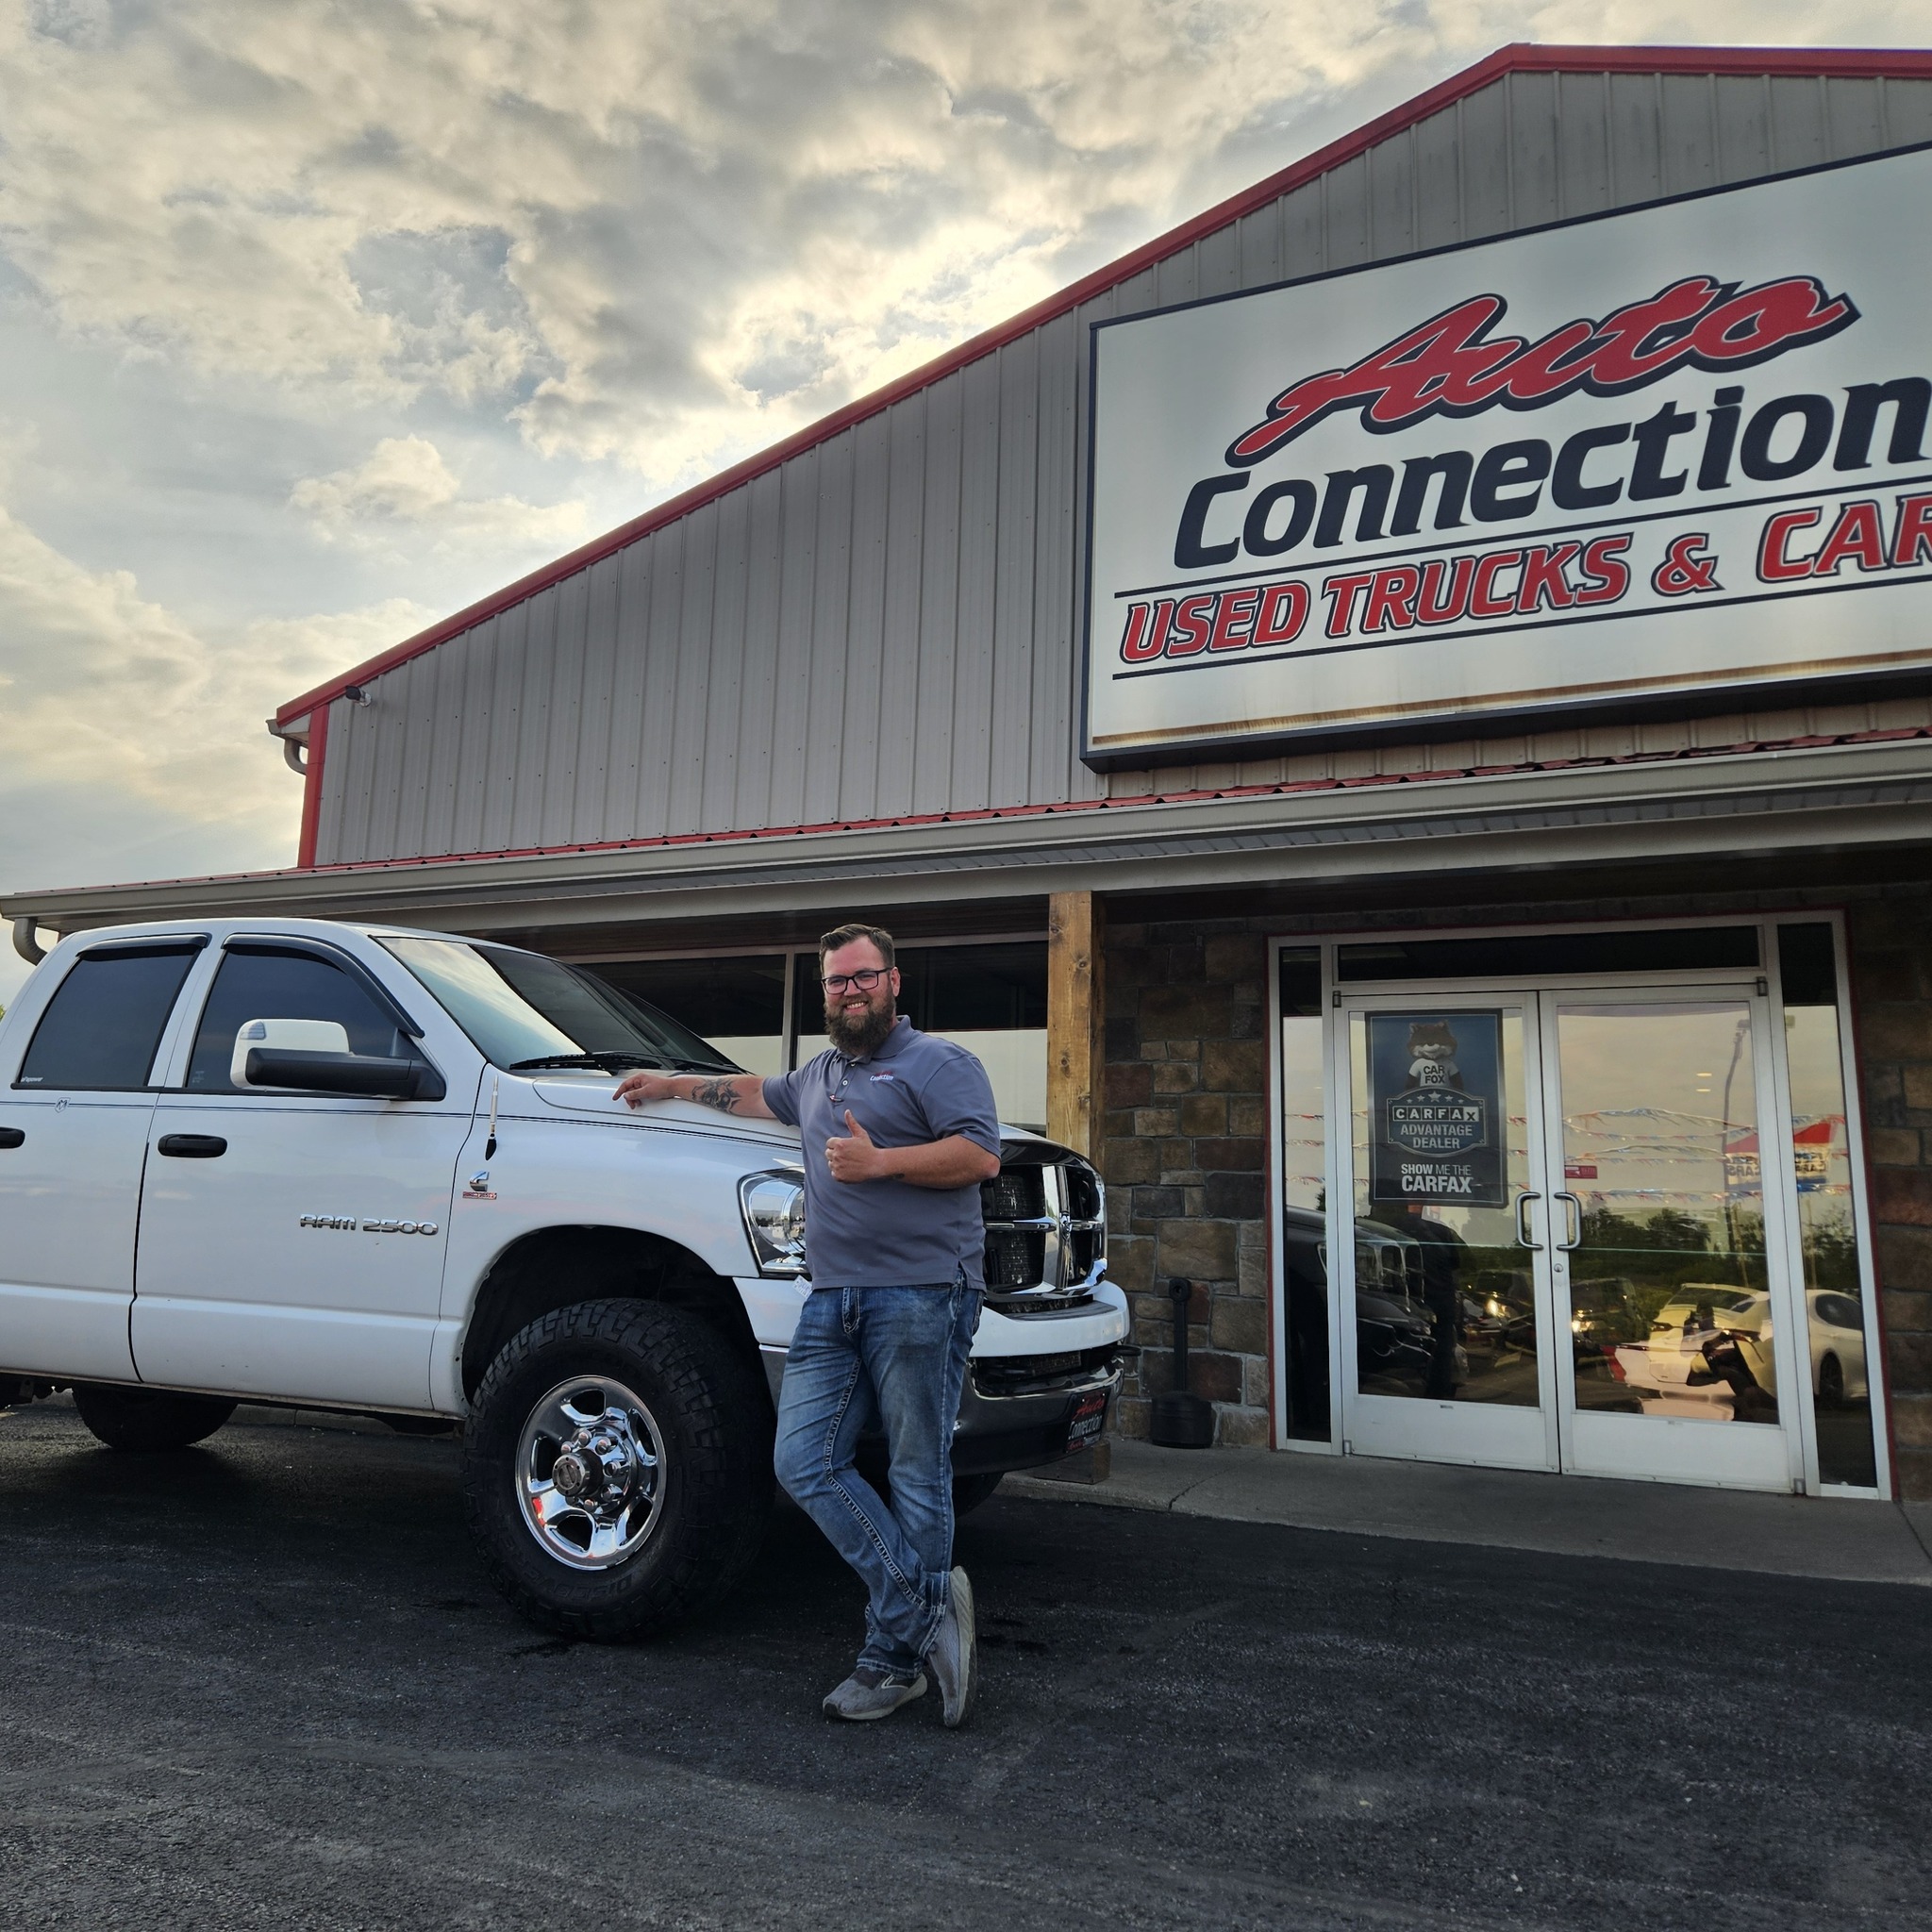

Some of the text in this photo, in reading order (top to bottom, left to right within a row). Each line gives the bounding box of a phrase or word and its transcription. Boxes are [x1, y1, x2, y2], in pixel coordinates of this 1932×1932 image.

[1225, 275, 1862, 467] Auto
[1174, 376, 1932, 569] Connection
[1120, 580, 1310, 664] USED
[1321, 531, 1634, 639] TRUCKS
[1651, 533, 1725, 597] &
[1423, 1065, 1445, 1075] CAR
[1424, 1074, 1445, 1084] FOX
[1394, 1107, 1477, 1122] CARFAX
[1400, 1124, 1474, 1136] ADVANTAGE
[1412, 1137, 1461, 1149] DEALER
[1401, 1163, 1472, 1176] SHOW ME THE
[1401, 1174, 1473, 1193] CARFAX
[299, 1213, 440, 1236] RAM 2500
